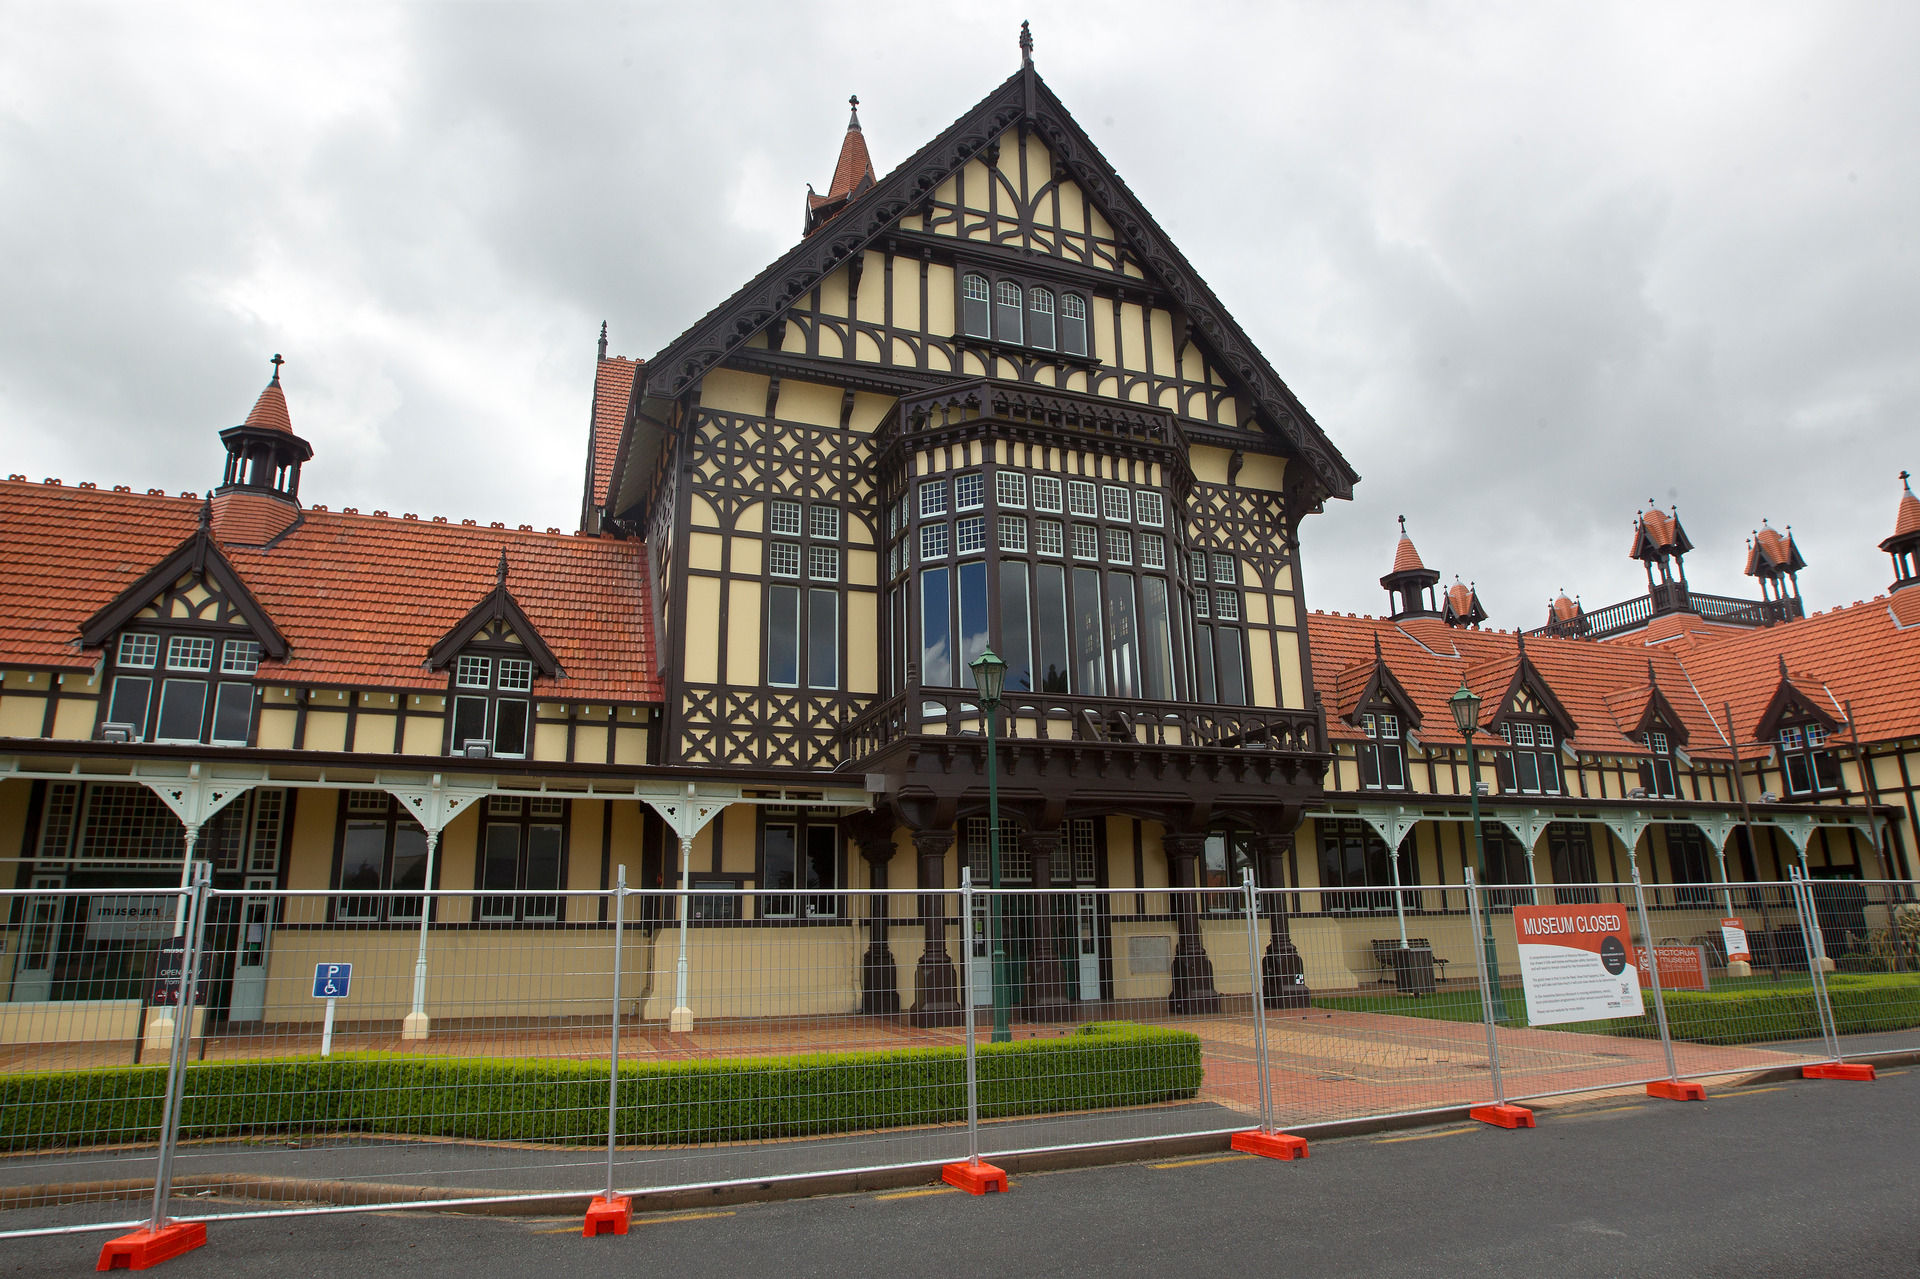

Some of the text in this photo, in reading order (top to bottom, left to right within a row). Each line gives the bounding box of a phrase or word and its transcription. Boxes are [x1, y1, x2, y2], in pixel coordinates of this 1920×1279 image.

[98, 907, 159, 916] museum
[1524, 915, 1620, 934] MUSEUM CLOSED
[328, 966, 339, 978] P
